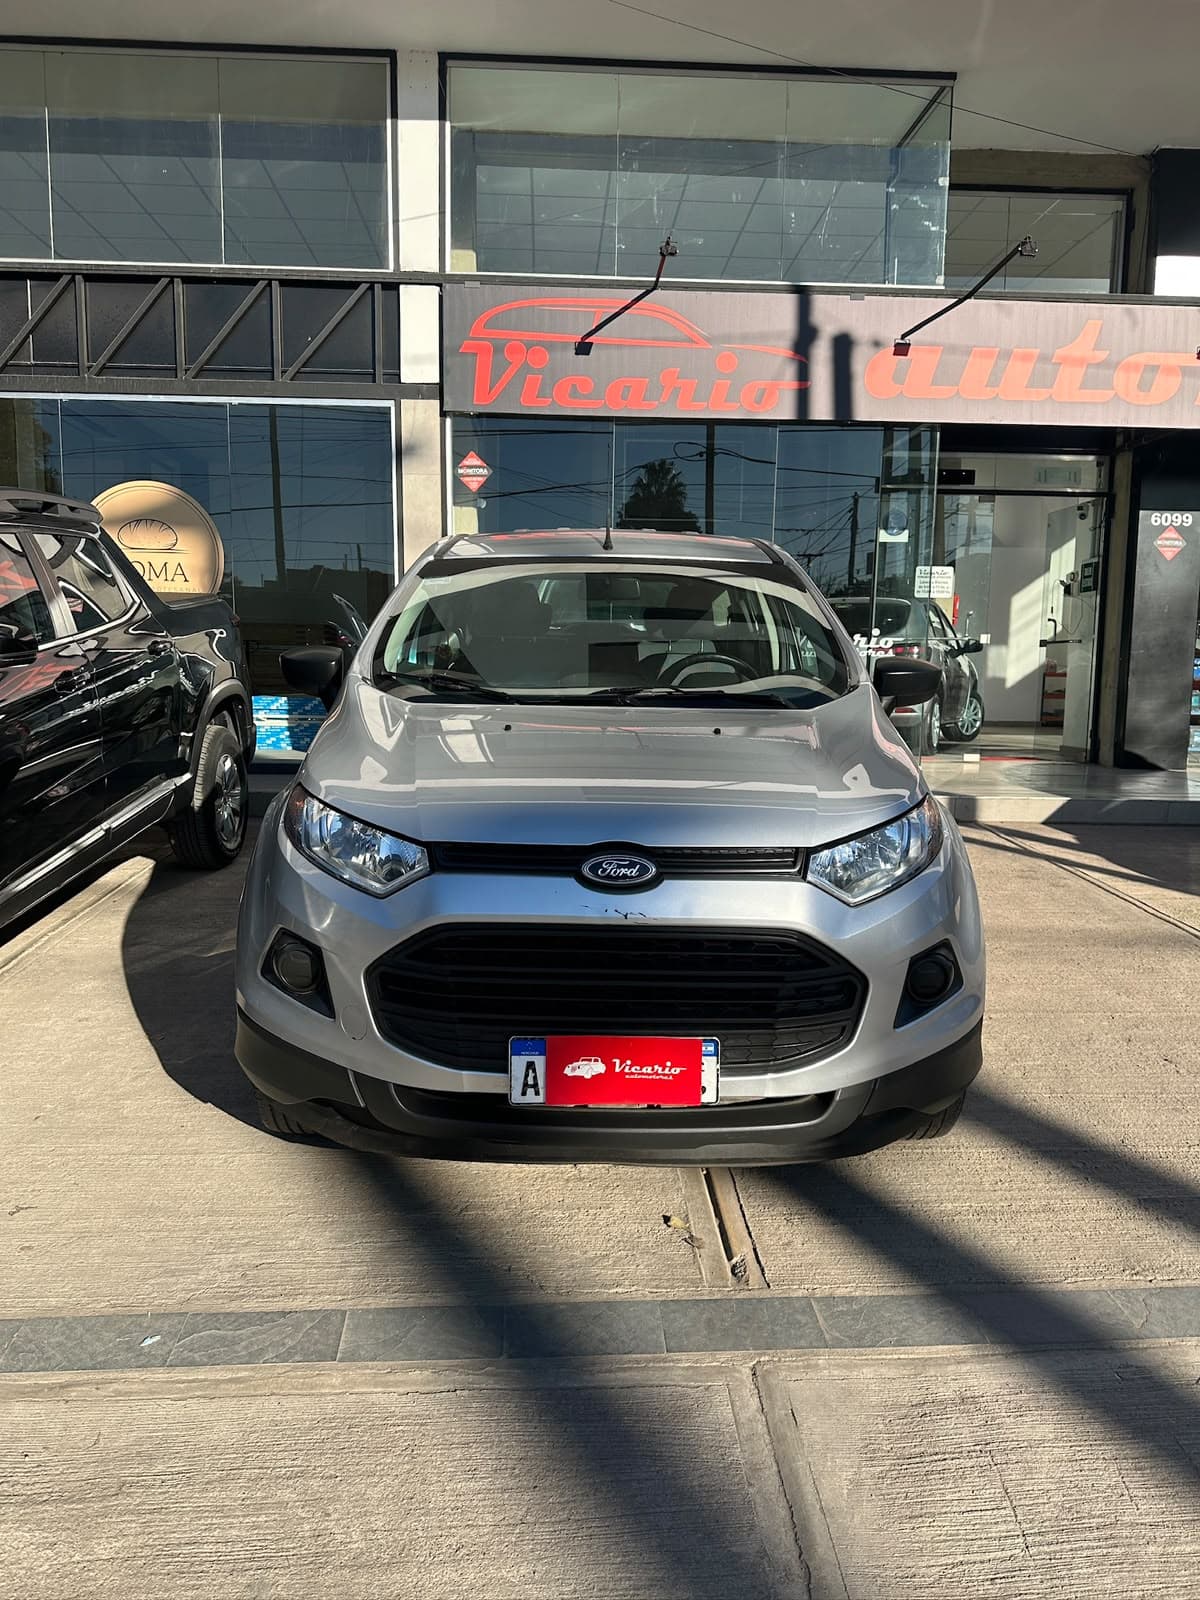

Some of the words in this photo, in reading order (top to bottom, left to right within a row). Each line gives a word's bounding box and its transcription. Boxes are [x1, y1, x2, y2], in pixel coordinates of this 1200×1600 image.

[459, 340, 812, 412] Vicario
[864, 319, 1200, 406] auto
[1151, 512, 1193, 527] 6099
[131, 560, 190, 583] OMA
[853, 627, 908, 649] rio
[598, 860, 641, 877] Ford
[612, 1058, 688, 1075] Vicario
[520, 1060, 541, 1097] A
